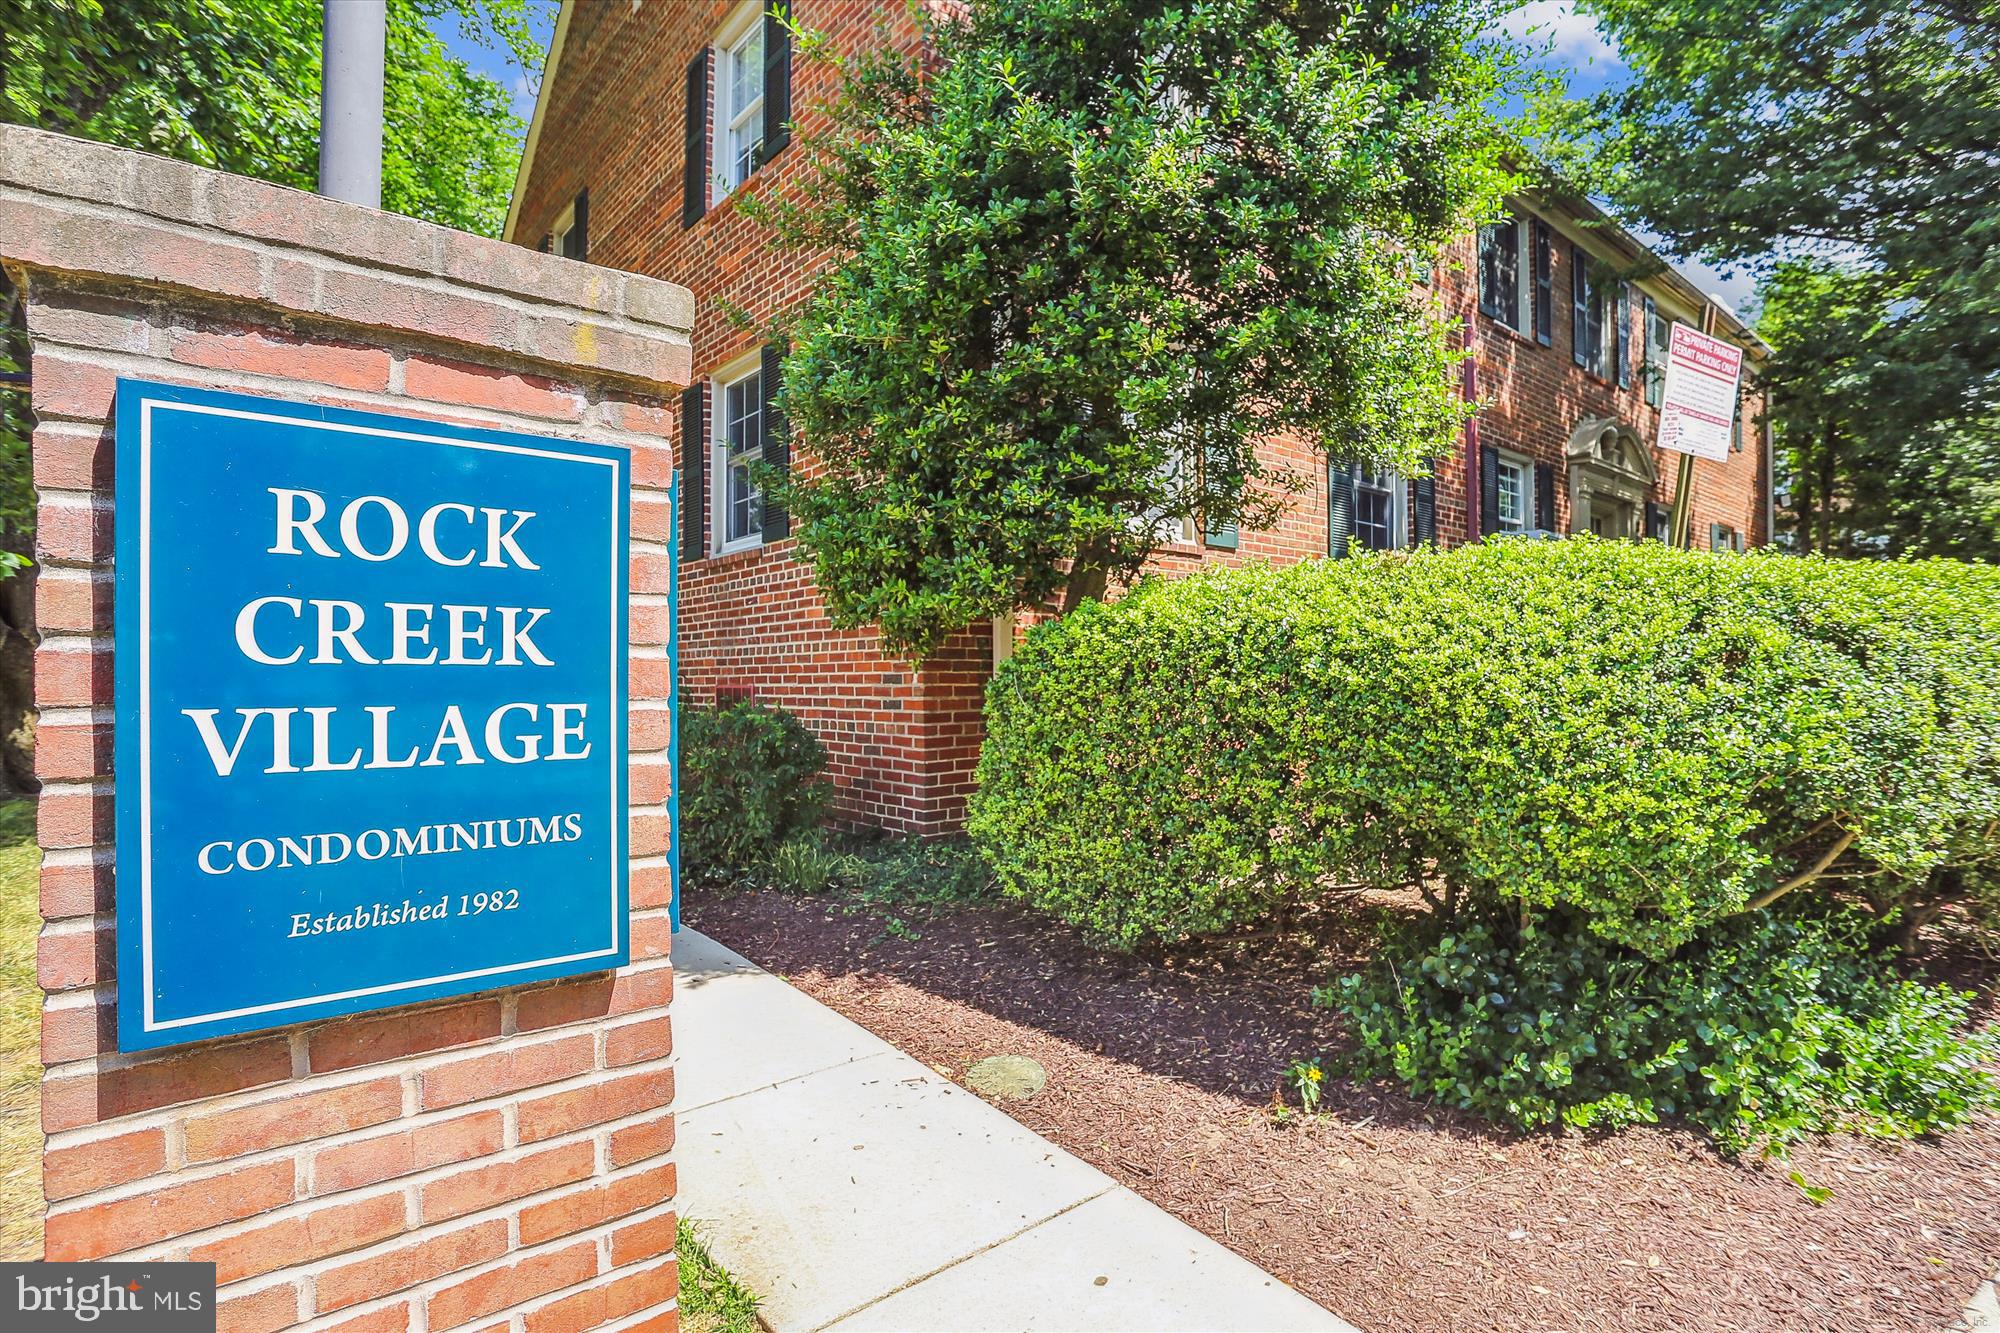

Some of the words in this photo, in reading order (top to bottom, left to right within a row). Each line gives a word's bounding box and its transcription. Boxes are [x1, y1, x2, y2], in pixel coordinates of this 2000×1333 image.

[1673, 341, 1696, 360] PERMIT
[1695, 351, 1722, 370] PARKING
[1721, 361, 1738, 375] ONLY
[1690, 335, 1714, 354] PRIVATE
[1713, 343, 1739, 362] PARKING
[267, 487, 541, 571] ROCK
[235, 596, 555, 666] CREEK
[180, 702, 592, 777] VILLAGE
[197, 813, 582, 875] CONDOMINIUMS
[287, 895, 449, 938] Established
[457, 889, 520, 916] 1982
